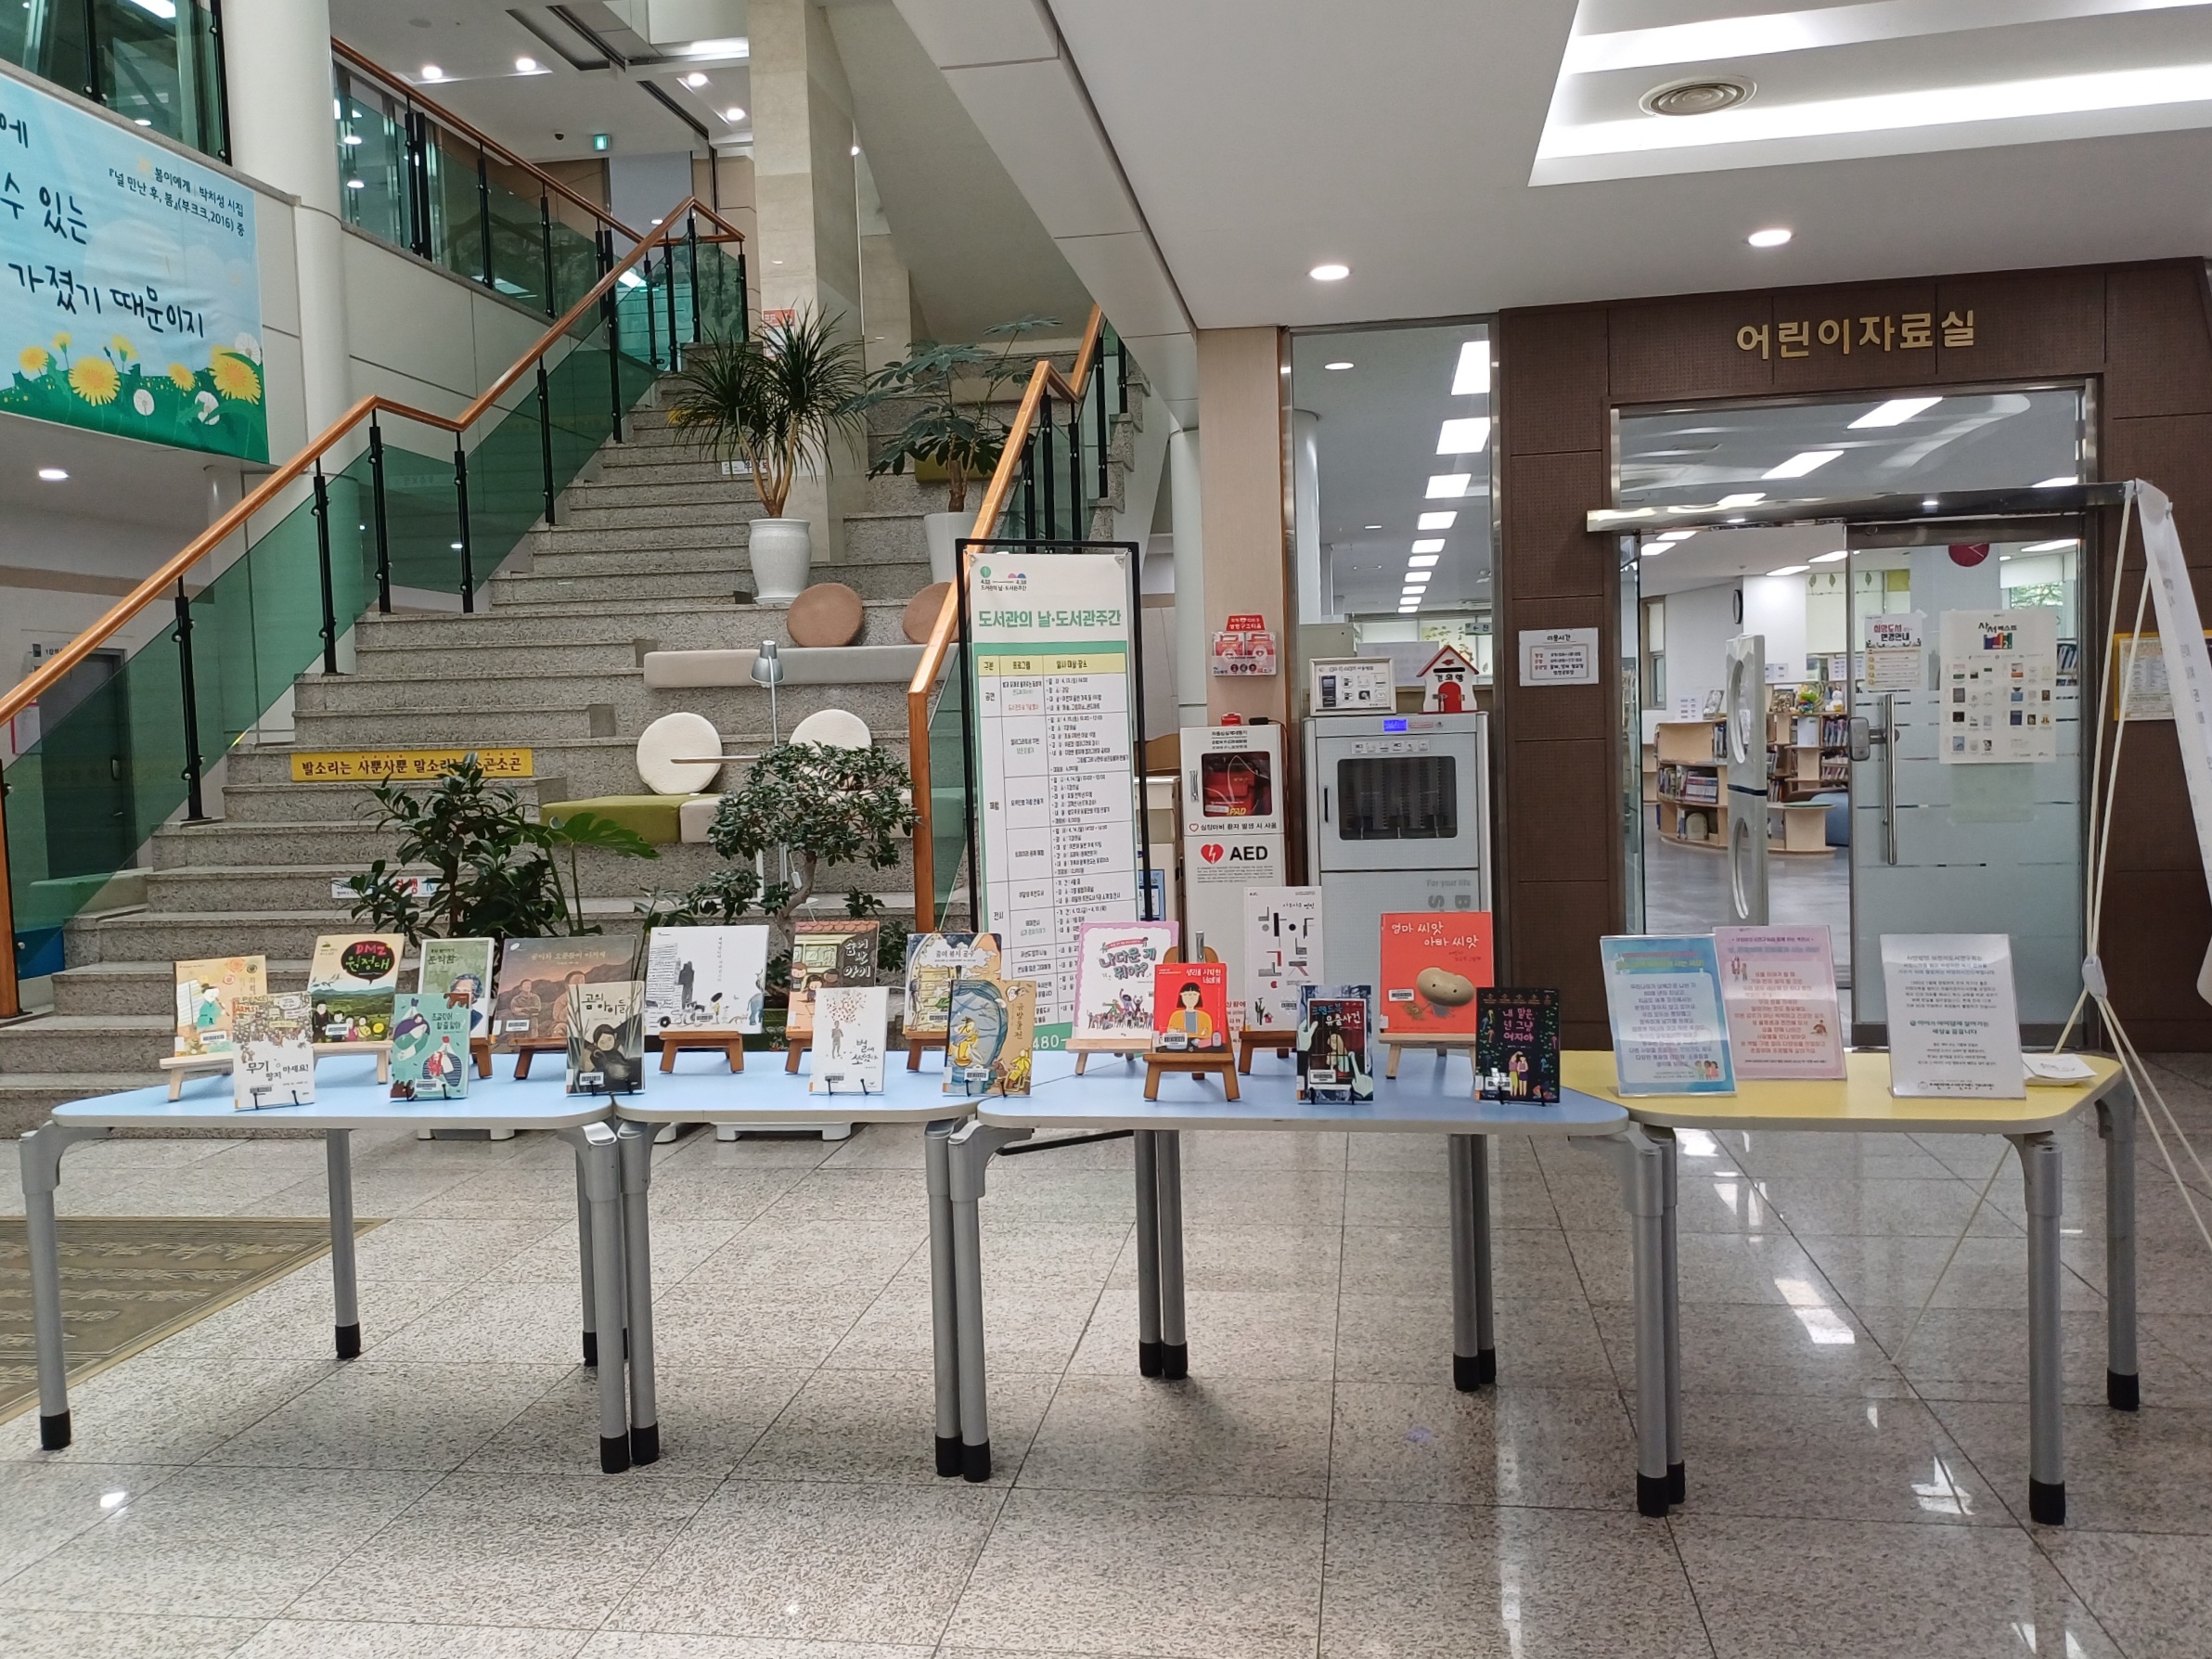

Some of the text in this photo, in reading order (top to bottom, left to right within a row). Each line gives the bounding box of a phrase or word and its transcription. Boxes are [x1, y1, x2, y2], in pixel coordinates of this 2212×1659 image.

[155, 167, 244, 218] 봄이에게 박치성 시집
[0, 172, 87, 245] 수 있는
[149, 186, 162, 204] 후,
[237, 223, 244, 237] 중
[7, 263, 204, 338] 가졌기 때문이지
[1736, 310, 1974, 360] 어린이자료실
[979, 611, 1033, 627] 도서관의
[1547, 634, 1572, 642] 이용시간
[1013, 661, 1030, 670] 프로그램
[302, 760, 353, 776] 발소리는
[358, 758, 408, 775] 사뿐사뿐
[1229, 846, 1268, 861] AED
[994, 911, 1004, 920] 전시
[1392, 920, 1444, 935] 엄마 씨앗
[845, 939, 868, 956] 숨어
[1424, 934, 1480, 949] 아빠 씨앗
[355, 944, 387, 956] DMZ
[346, 956, 391, 971] 원정대
[428, 955, 456, 965] 문익환
[1100, 947, 1157, 969] 나다운 게
[843, 966, 870, 978] 아이
[1113, 963, 1149, 980] 뭐야?
[1202, 968, 1221, 976] 시작한
[581, 994, 626, 1015] 곰의 아이들
[1502, 1009, 1513, 1017] 내
[1504, 1020, 1534, 1031] 넌 그냥
[246, 1061, 269, 1074] 무기
[265, 1064, 309, 1081] 팔지 마세요!
